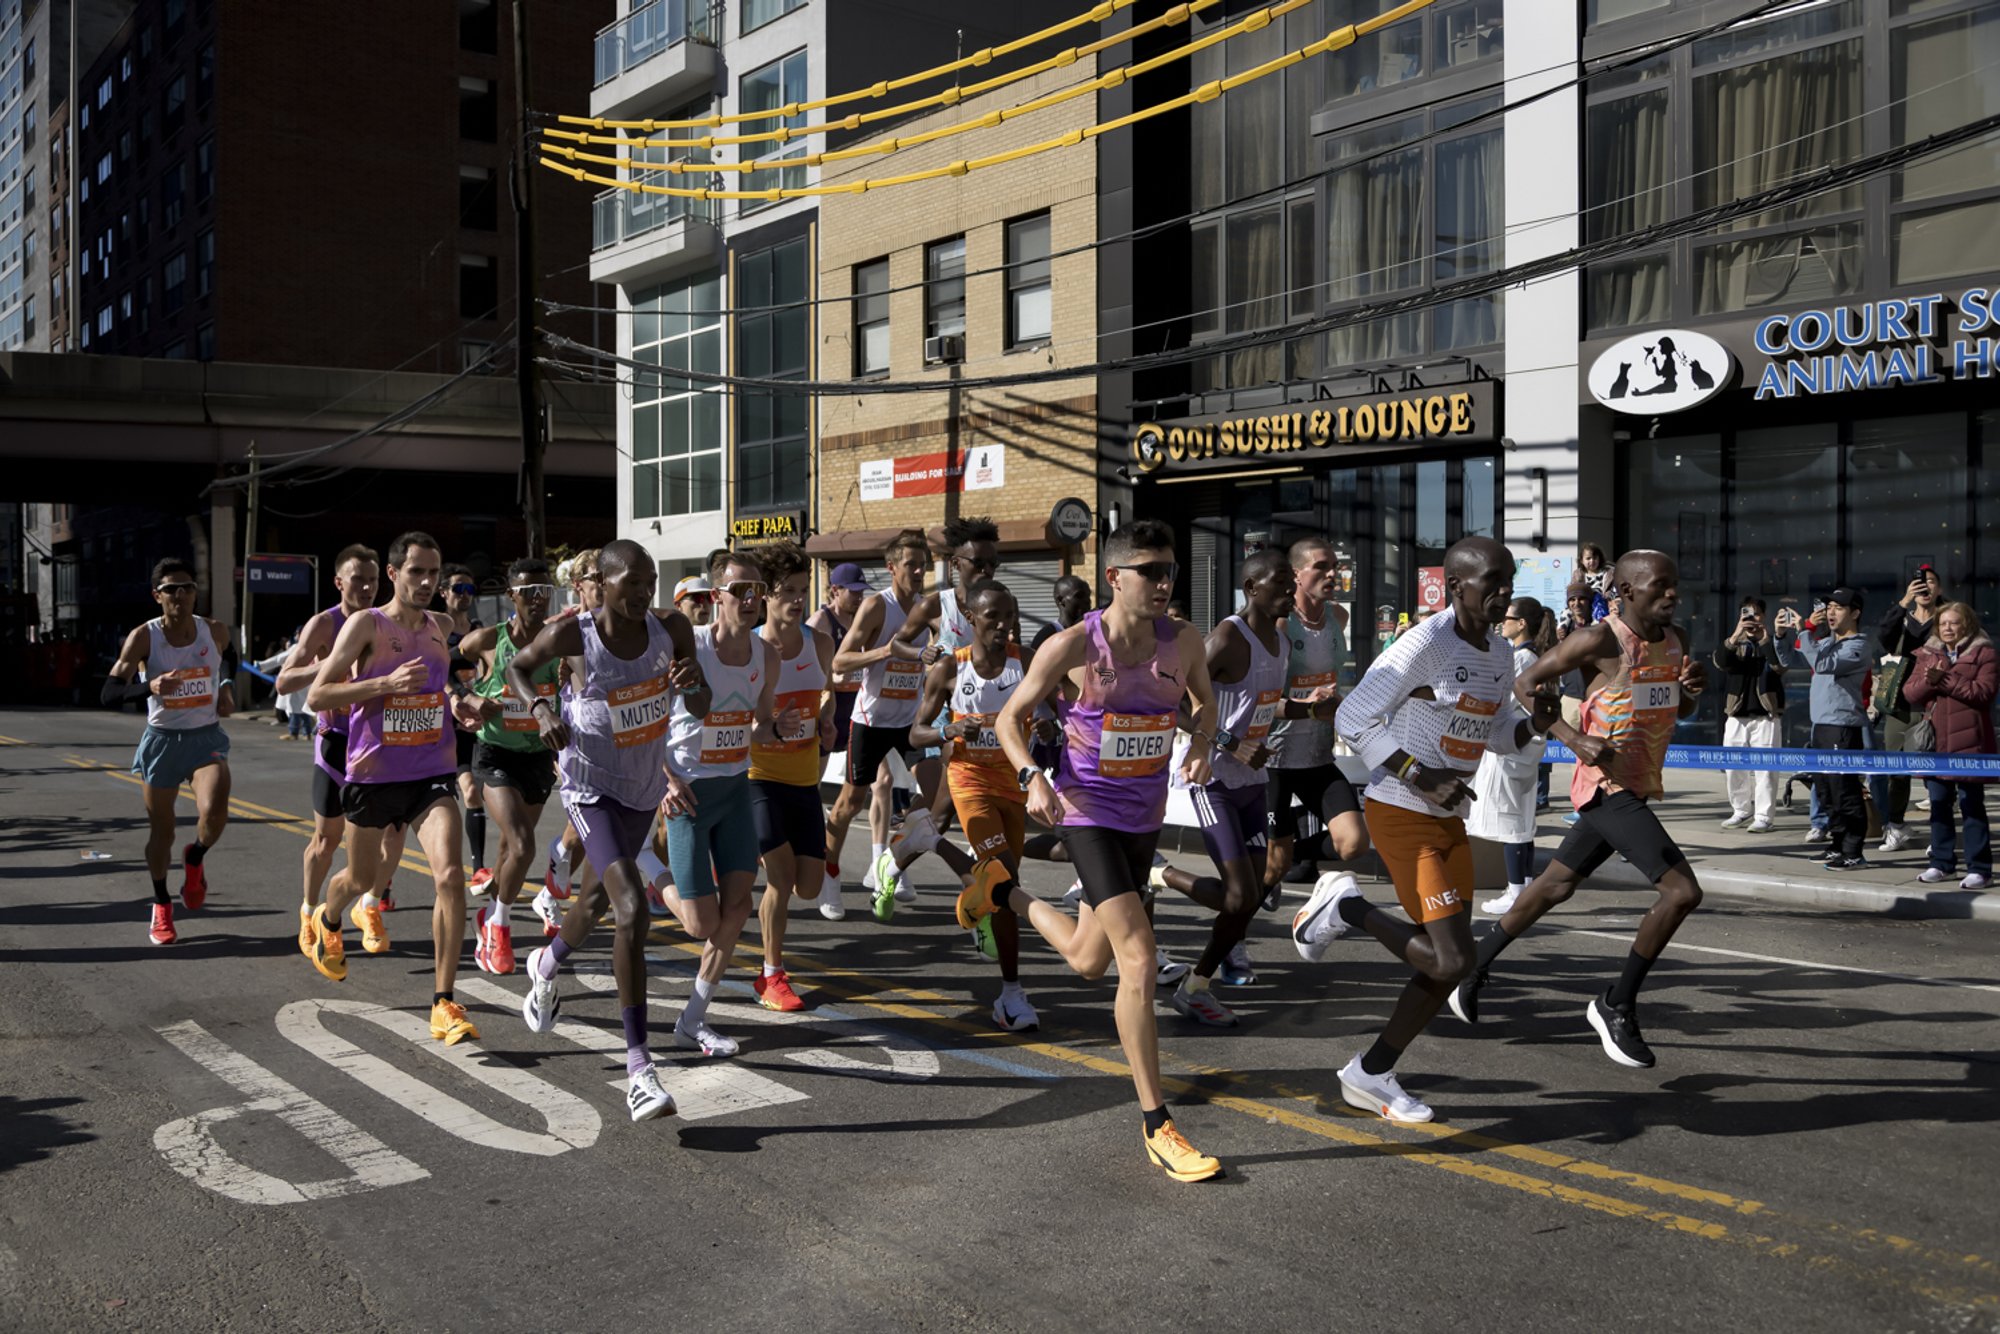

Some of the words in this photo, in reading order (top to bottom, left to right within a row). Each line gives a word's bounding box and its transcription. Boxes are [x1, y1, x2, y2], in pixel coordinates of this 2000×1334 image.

[1754, 293, 1942, 354] COURT
[1754, 345, 1938, 400] ANIMAL
[1220, 411, 1302, 455] SUSHI
[1310, 409, 1330, 446] &
[1338, 392, 1470, 444] LOUNGE
[895, 470, 928, 483] BUILDING
[929, 468, 943, 478] FOR
[944, 465, 963, 476] SALE
[734, 519, 760, 536] CHEF
[763, 516, 792, 534] PAPA
[266, 571, 293, 580] Water
[888, 674, 917, 688] KYBURZ
[1649, 687, 1671, 706] BOR
[620, 696, 667, 729] MUTISO
[1113, 716, 1130, 727] tcs
[716, 730, 744, 747] BOUR
[1116, 736, 1163, 757] DEVER
[1699, 751, 1725, 764] POLICE
[1726, 752, 1744, 764] LINE
[1762, 754, 1777, 765] NOT
[1779, 754, 1807, 767] CROSS
[1817, 754, 1844, 767] POLICE
[1847, 755, 1867, 767] LINE
[1873, 757, 1885, 768] DO
[1887, 757, 1904, 769] NOT
[1906, 757, 1936, 769] CROSS
[1949, 757, 1980, 769] POLICE
